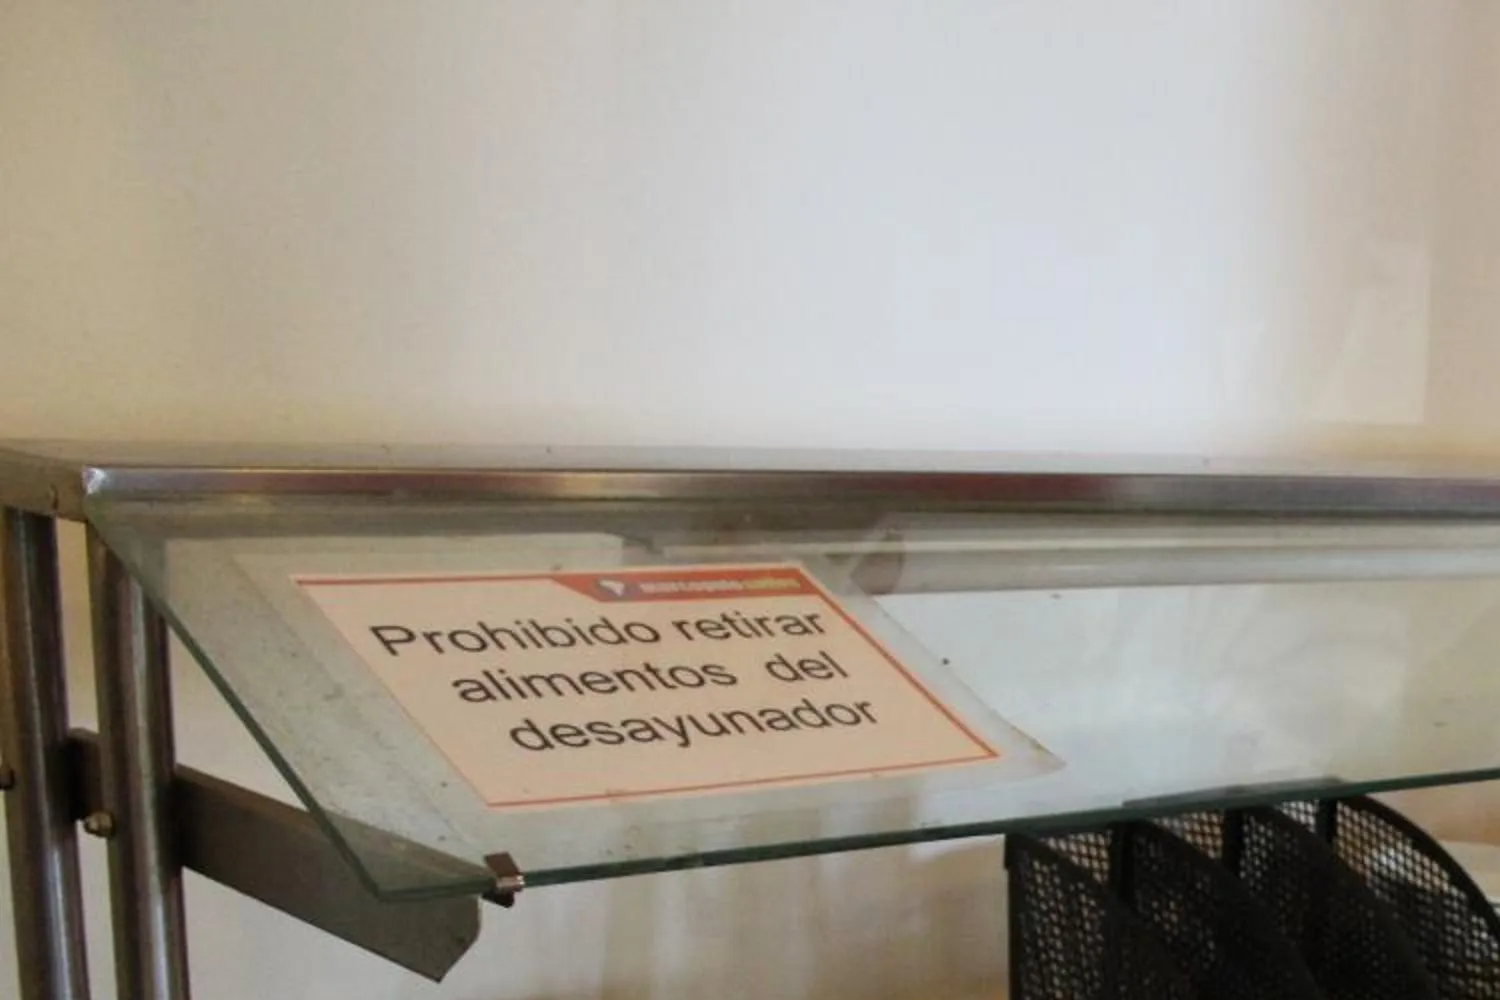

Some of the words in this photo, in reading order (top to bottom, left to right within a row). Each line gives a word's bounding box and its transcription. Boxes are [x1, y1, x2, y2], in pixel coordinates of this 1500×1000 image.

[368, 616, 661, 657] Prohibido
[671, 612, 826, 642] retirar
[451, 668, 738, 703] alimentos
[765, 650, 848, 682] del
[509, 698, 877, 751] desayunador
